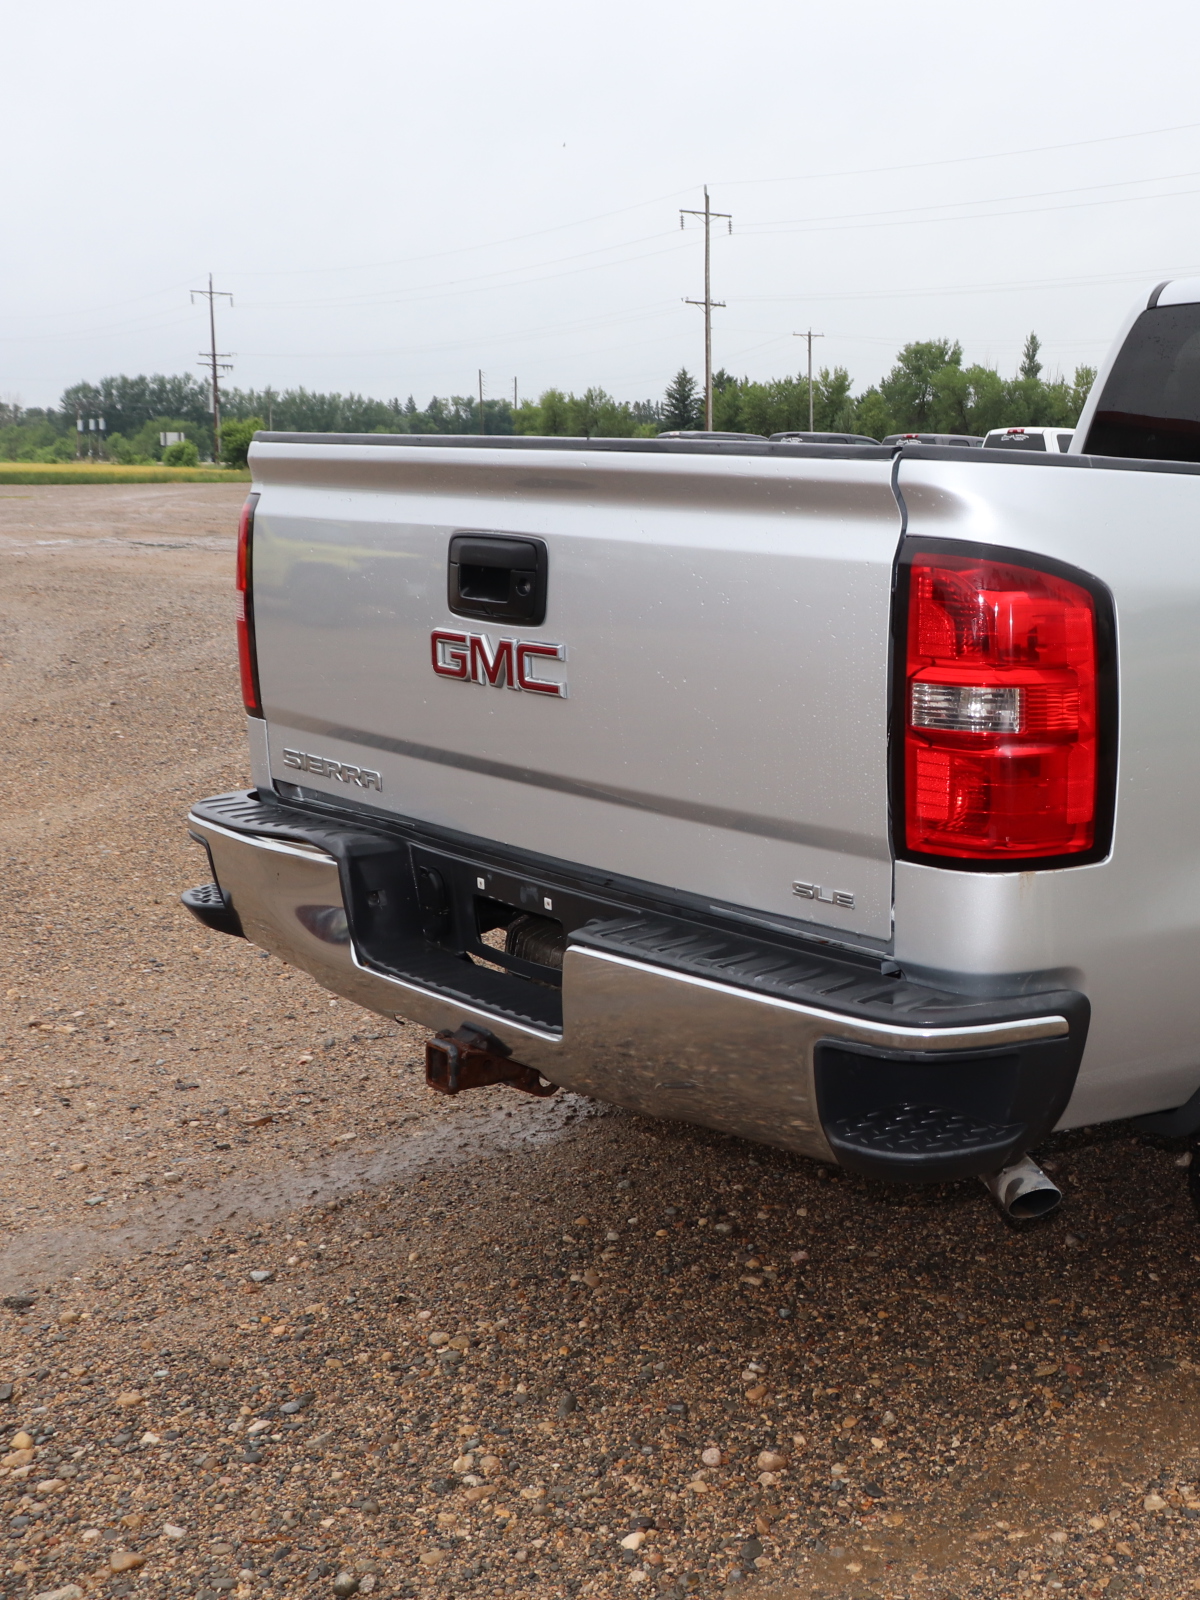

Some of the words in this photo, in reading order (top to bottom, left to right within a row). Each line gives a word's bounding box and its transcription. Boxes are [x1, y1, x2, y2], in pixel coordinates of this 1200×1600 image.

[431, 627, 568, 699] GMC
[283, 747, 383, 792] SIERRA
[792, 880, 855, 911] SLE
